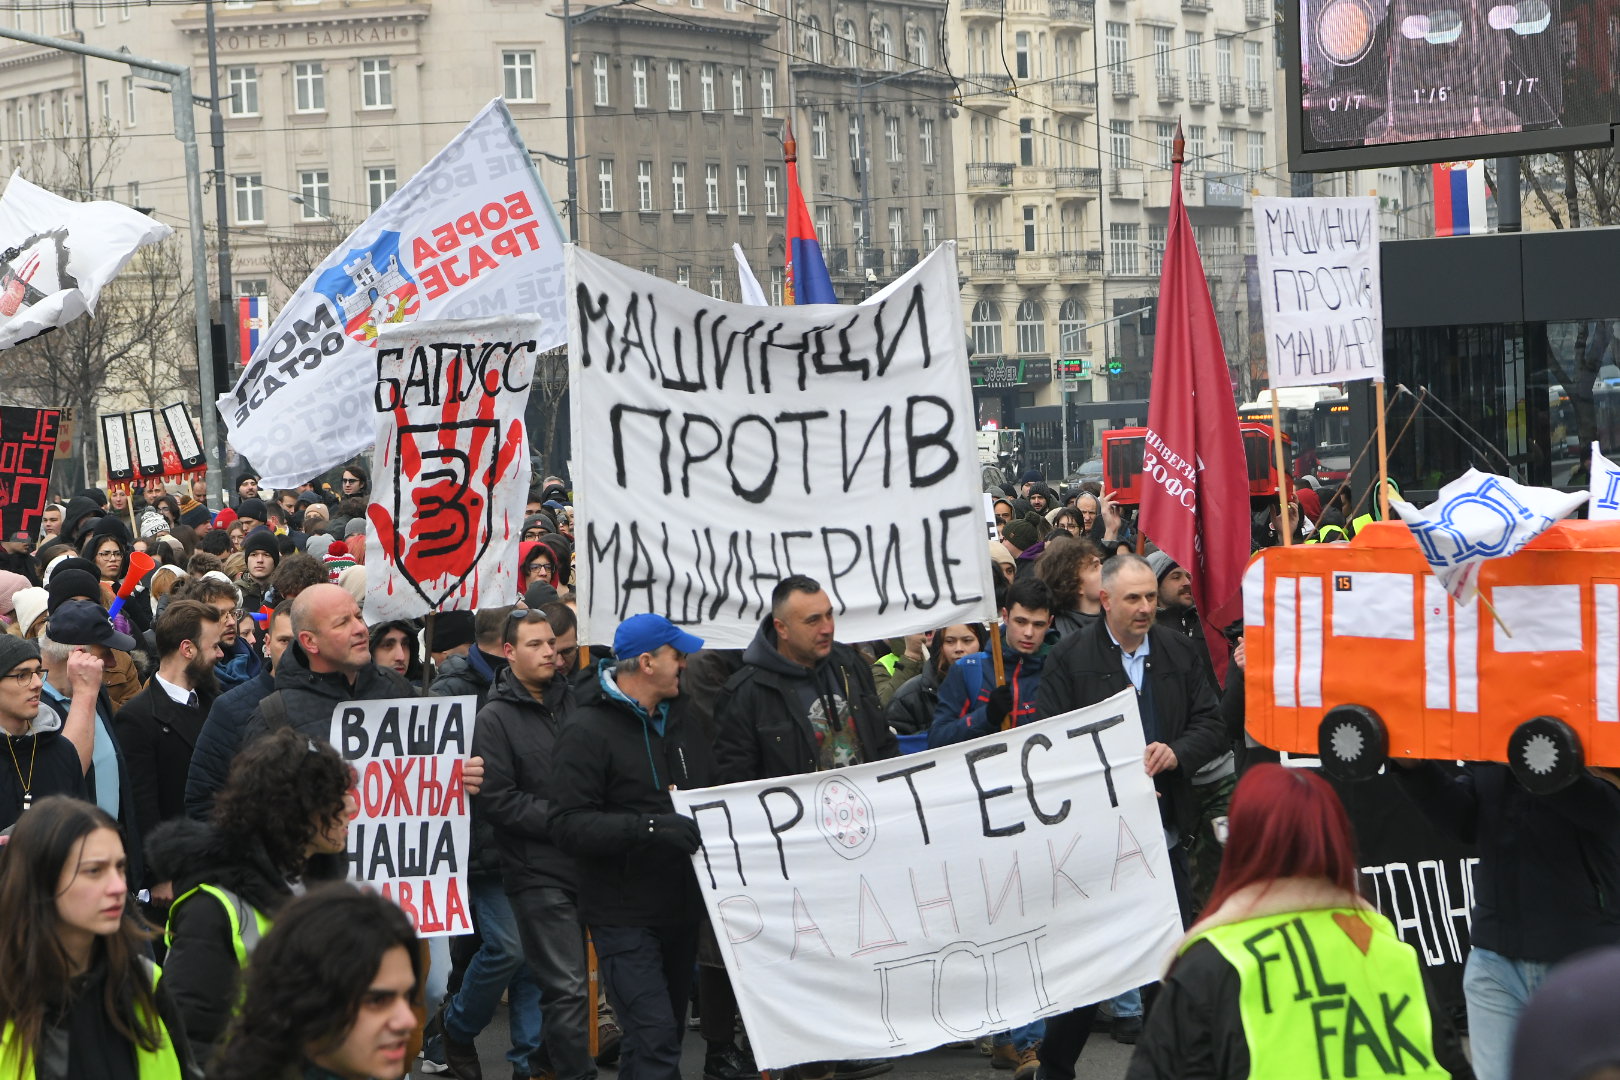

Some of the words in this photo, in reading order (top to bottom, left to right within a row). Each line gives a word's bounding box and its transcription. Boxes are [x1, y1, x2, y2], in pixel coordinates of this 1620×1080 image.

[214, 33, 286, 51] ХОТЕЛ
[306, 27, 397, 46] БАЛКАН
[374, 340, 537, 412] БАПУСС
[575, 282, 931, 394] МАШИНЦИ
[609, 395, 959, 503] ПРОТИВ
[1338, 577, 1351, 590] 15
[341, 702, 465, 761] ВАША
[717, 816, 1157, 970] РАДНИКА
[1243, 917, 1347, 1015] FIL
[1311, 992, 1432, 1080] FAK
